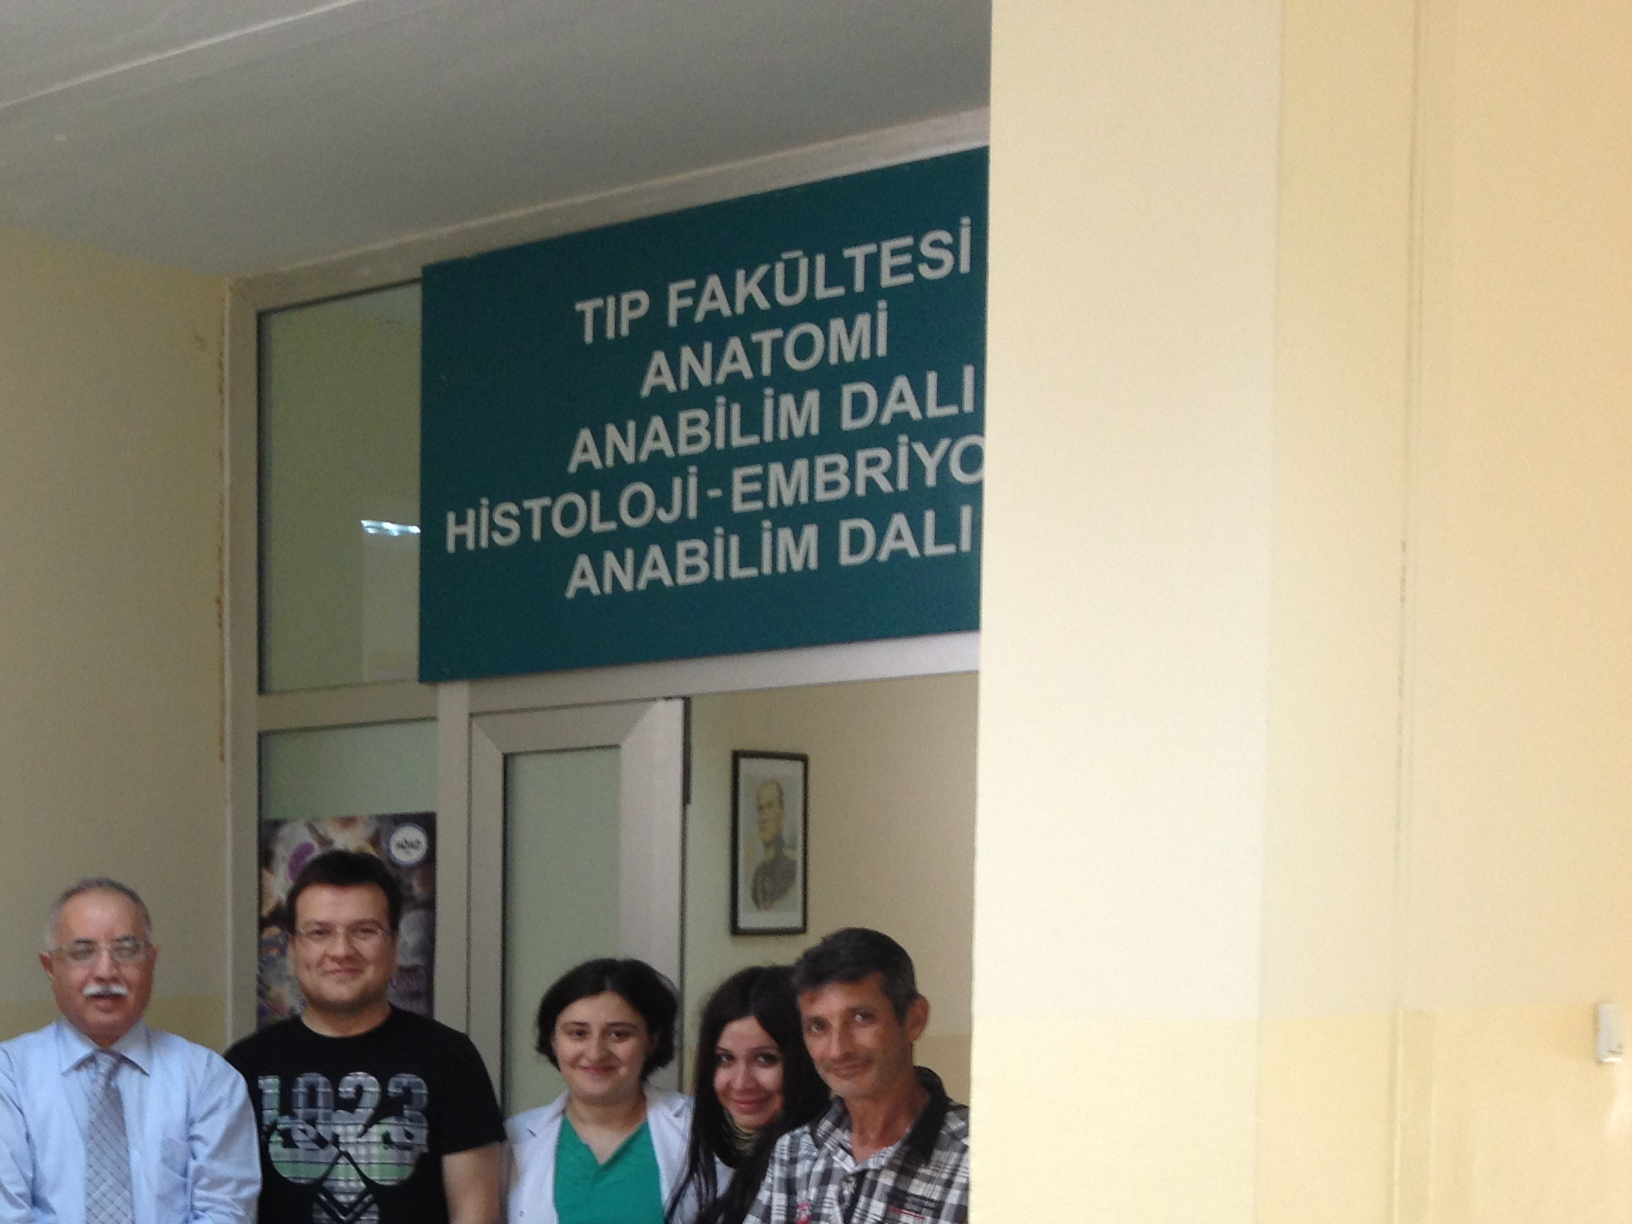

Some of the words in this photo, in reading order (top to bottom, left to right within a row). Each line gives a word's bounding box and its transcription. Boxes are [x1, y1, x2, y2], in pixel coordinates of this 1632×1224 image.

[574, 289, 651, 345] TIP
[640, 299, 889, 398] ANATOMİ
[567, 387, 822, 474] ANABİLİM
[840, 364, 976, 431] DALI
[564, 518, 820, 600] ANABİLİM
[837, 503, 973, 567] DALI
